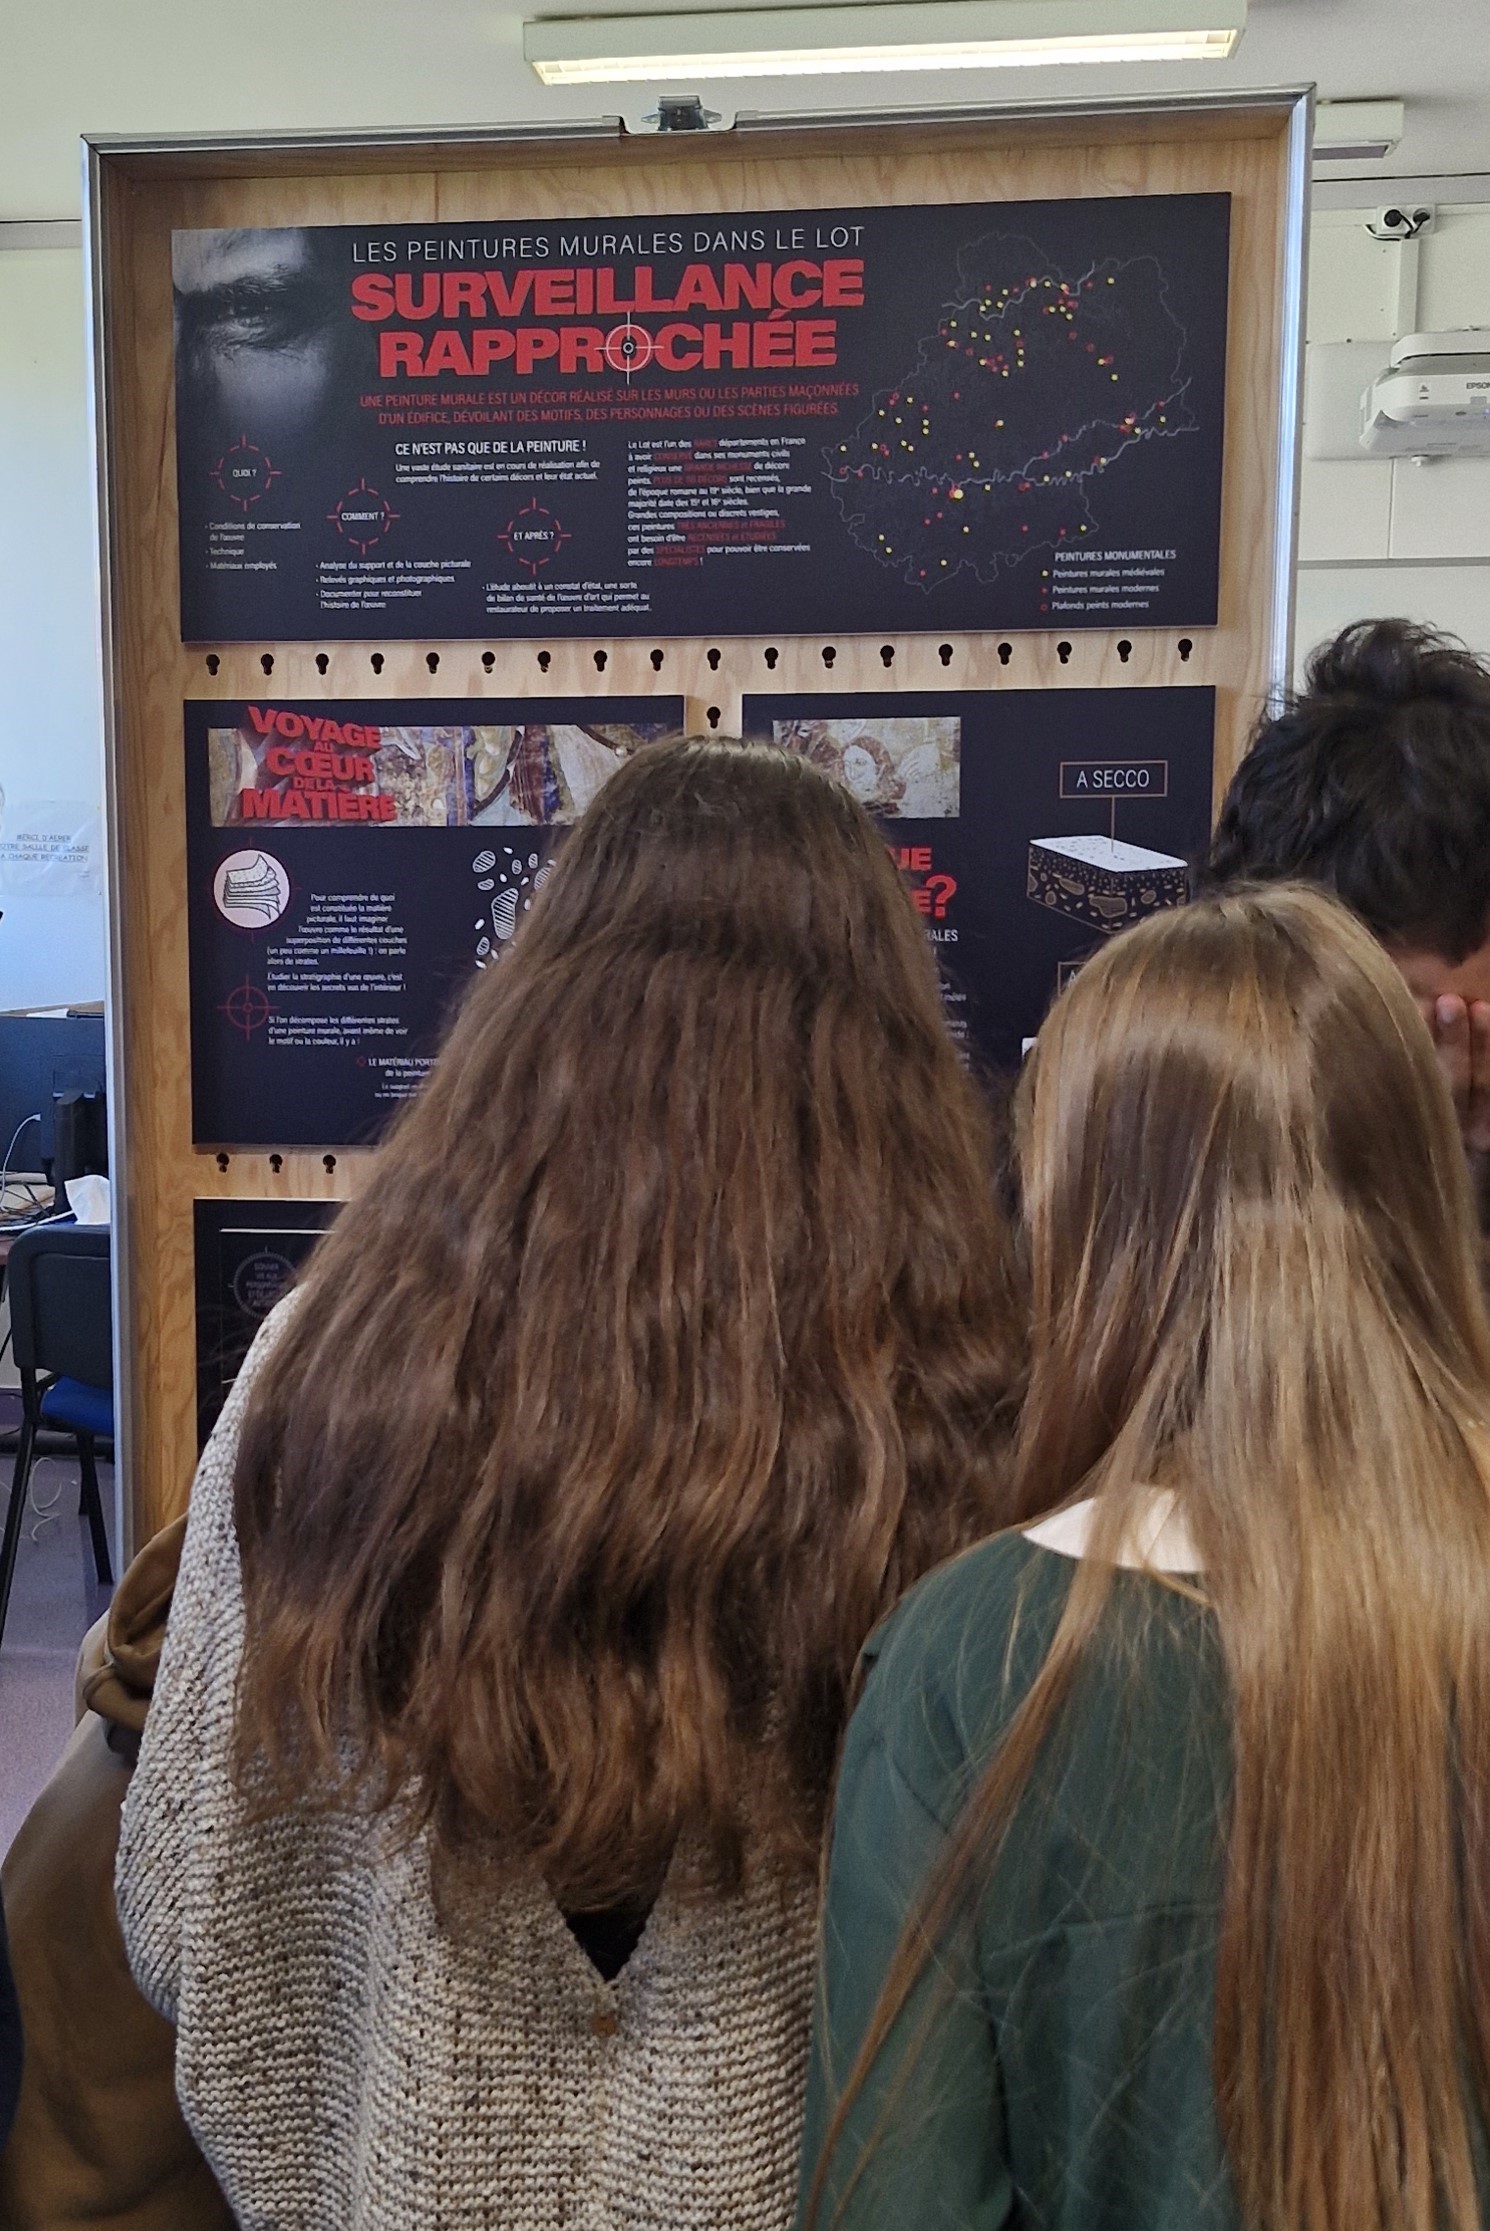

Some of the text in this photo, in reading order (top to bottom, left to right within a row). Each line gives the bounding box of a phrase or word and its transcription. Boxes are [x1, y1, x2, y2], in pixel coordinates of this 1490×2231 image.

[353, 226, 864, 262] LES PEINTURES MURALES DANS LE LOT
[351, 259, 864, 322] SURVEILLANCE
[380, 308, 837, 377] RAPPROCHÉE
[360, 382, 859, 407] UNE PEINTURE MURALE EST UN DÉCOR RÉALISÉ SUR LES MURS OU LES PARTIES MAÇONNÉES
[379, 413, 404, 424] D'UN
[453, 408, 512, 423] DÉVOILANT
[516, 410, 538, 421] DES
[586, 408, 607, 420] DES
[610, 407, 690, 419] PERSONNAGES
[694, 406, 709, 417] OU
[712, 406, 734, 417] DES
[738, 403, 780, 416] SCÈNES
[395, 440, 586, 455] CE N'EST PAS QUE DE LA PEINTURE !
[341, 512, 385, 521] COMMENT ?
[514, 532, 522, 540] ET
[524, 530, 548, 540] APRÈS
[1055, 550, 1176, 562] PEINTURES MONUMENTALES
[1052, 568, 1165, 578] Peintures murales médiévales
[1052, 585, 1159, 594] Peintures murales modernes
[248, 706, 382, 750] VOYAGE
[314, 741, 335, 752] AU
[266, 747, 375, 783] CŒUR
[1077, 770, 1150, 789] A SECCO
